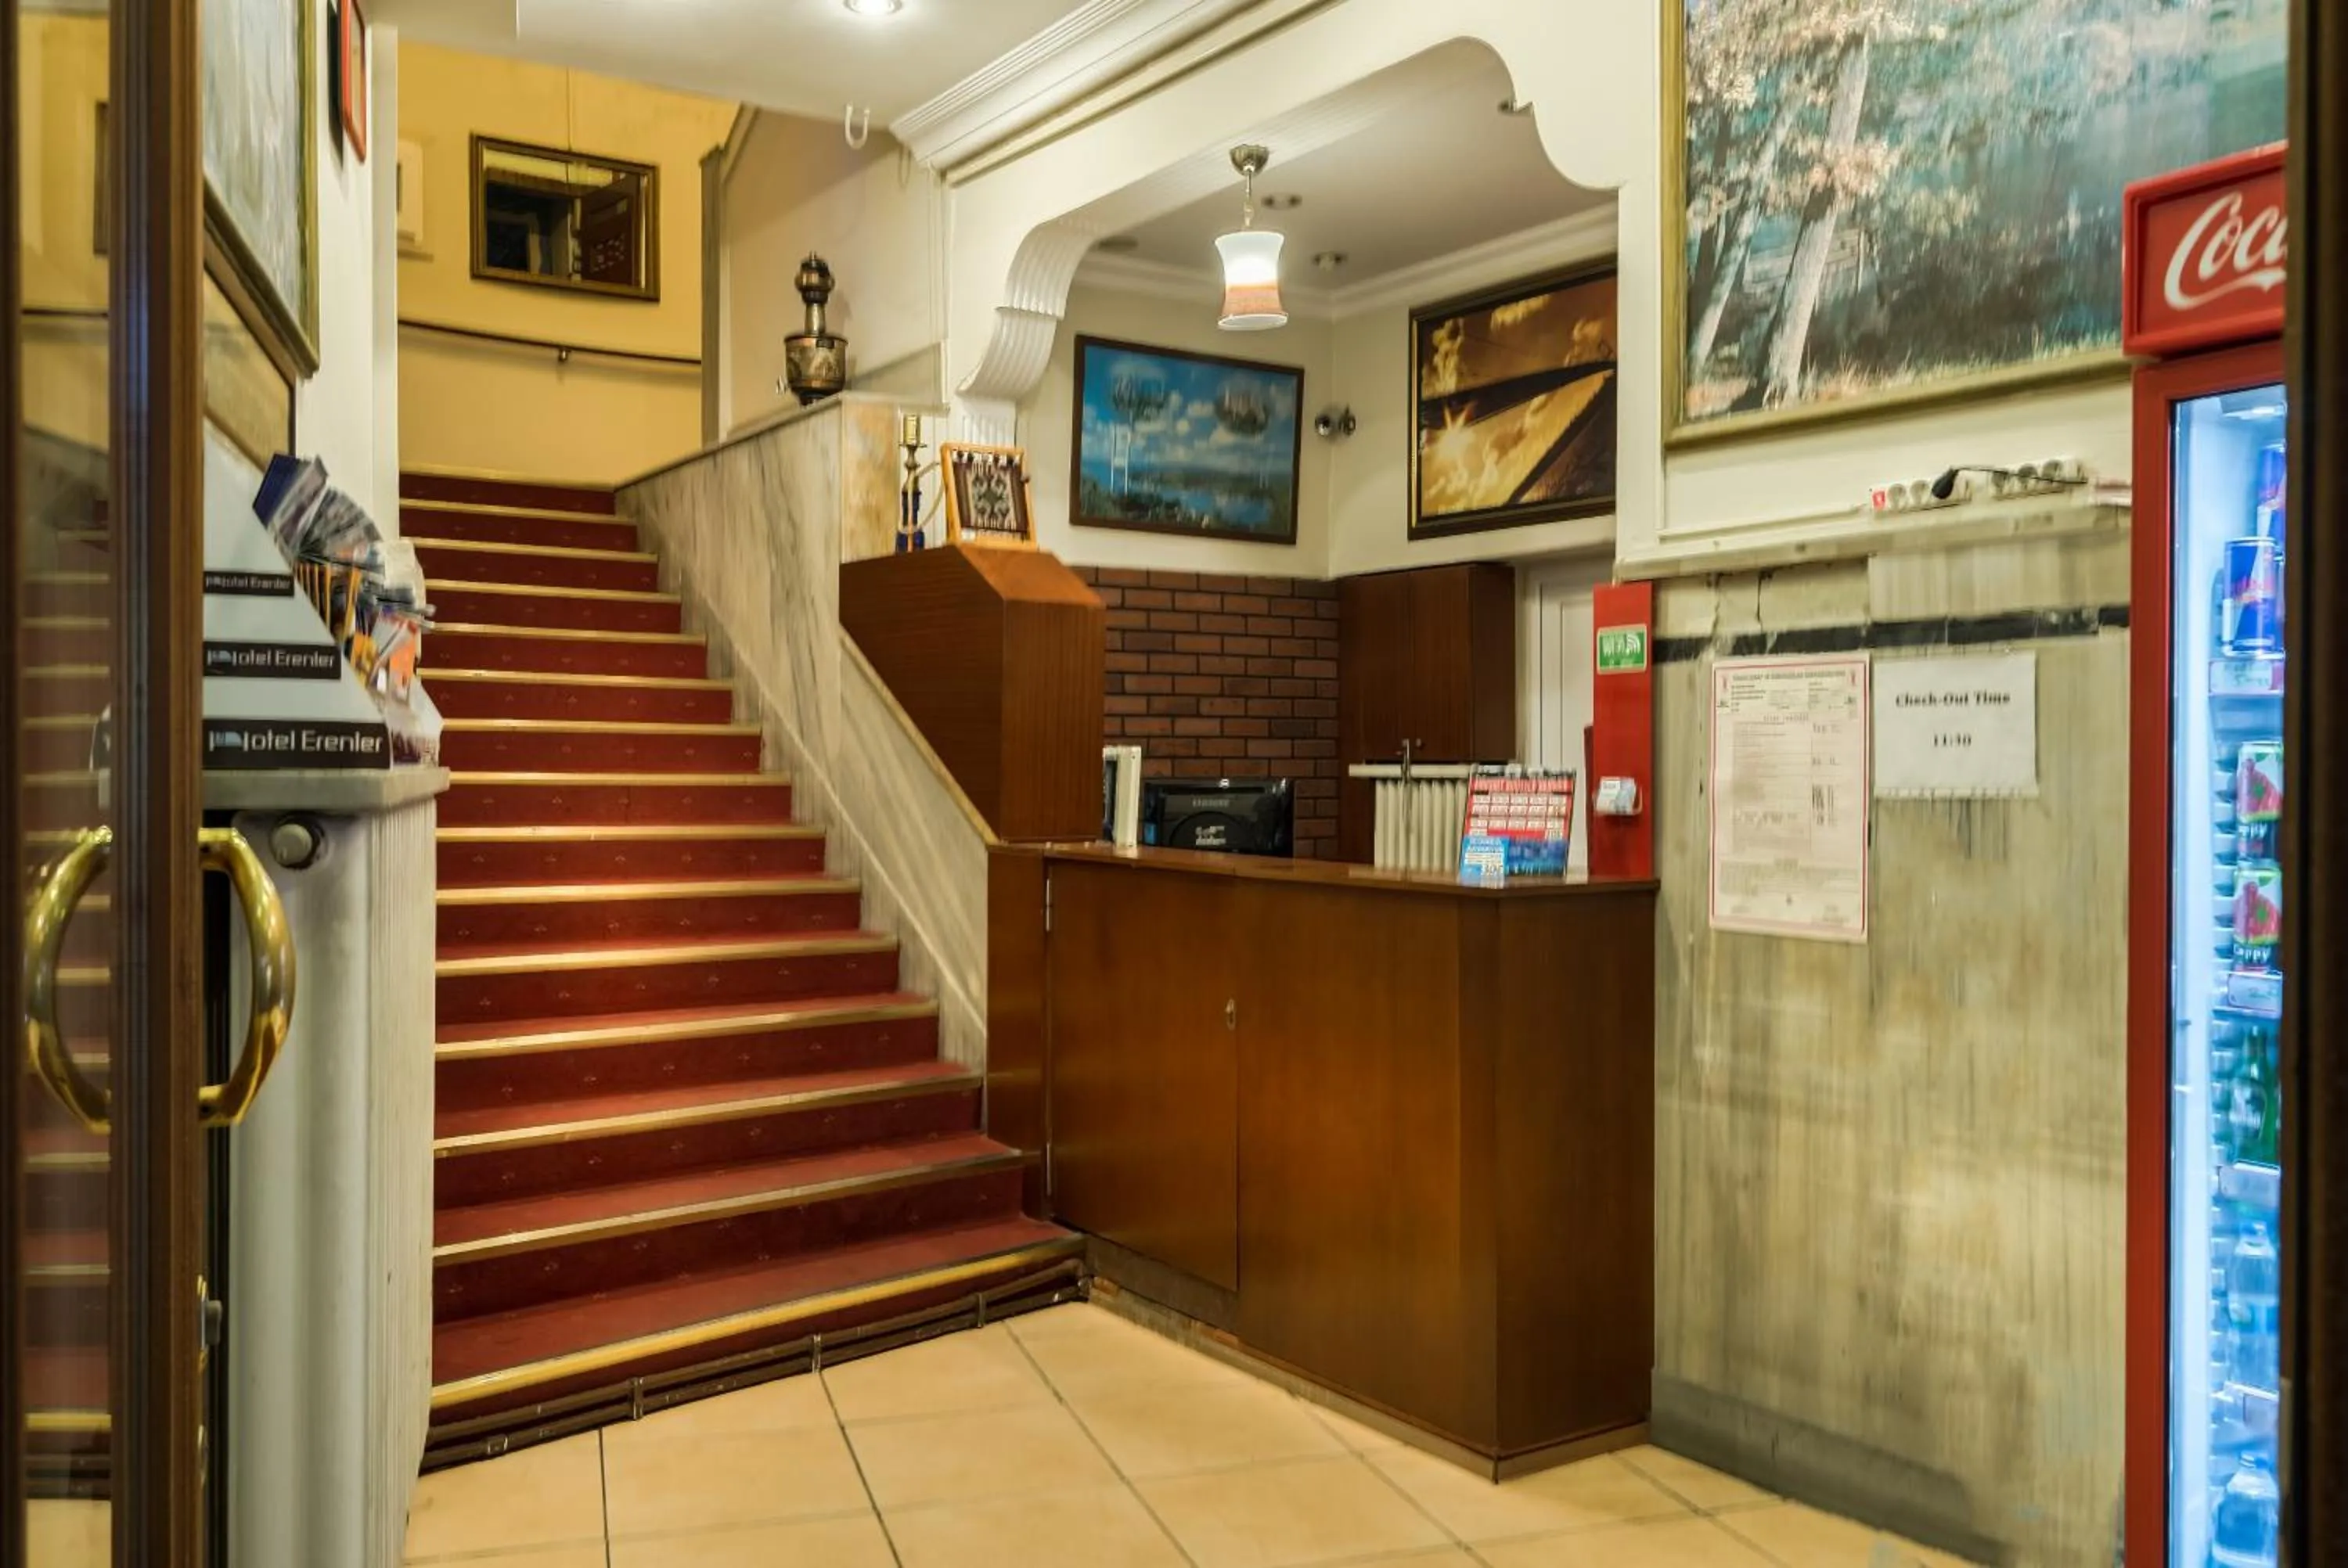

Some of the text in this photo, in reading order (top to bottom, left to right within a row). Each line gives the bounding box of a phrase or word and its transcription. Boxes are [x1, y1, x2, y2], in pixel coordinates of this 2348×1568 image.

[1895, 689, 2011, 708] Check-Out Time
[208, 728, 384, 753] Hotel Erenler
